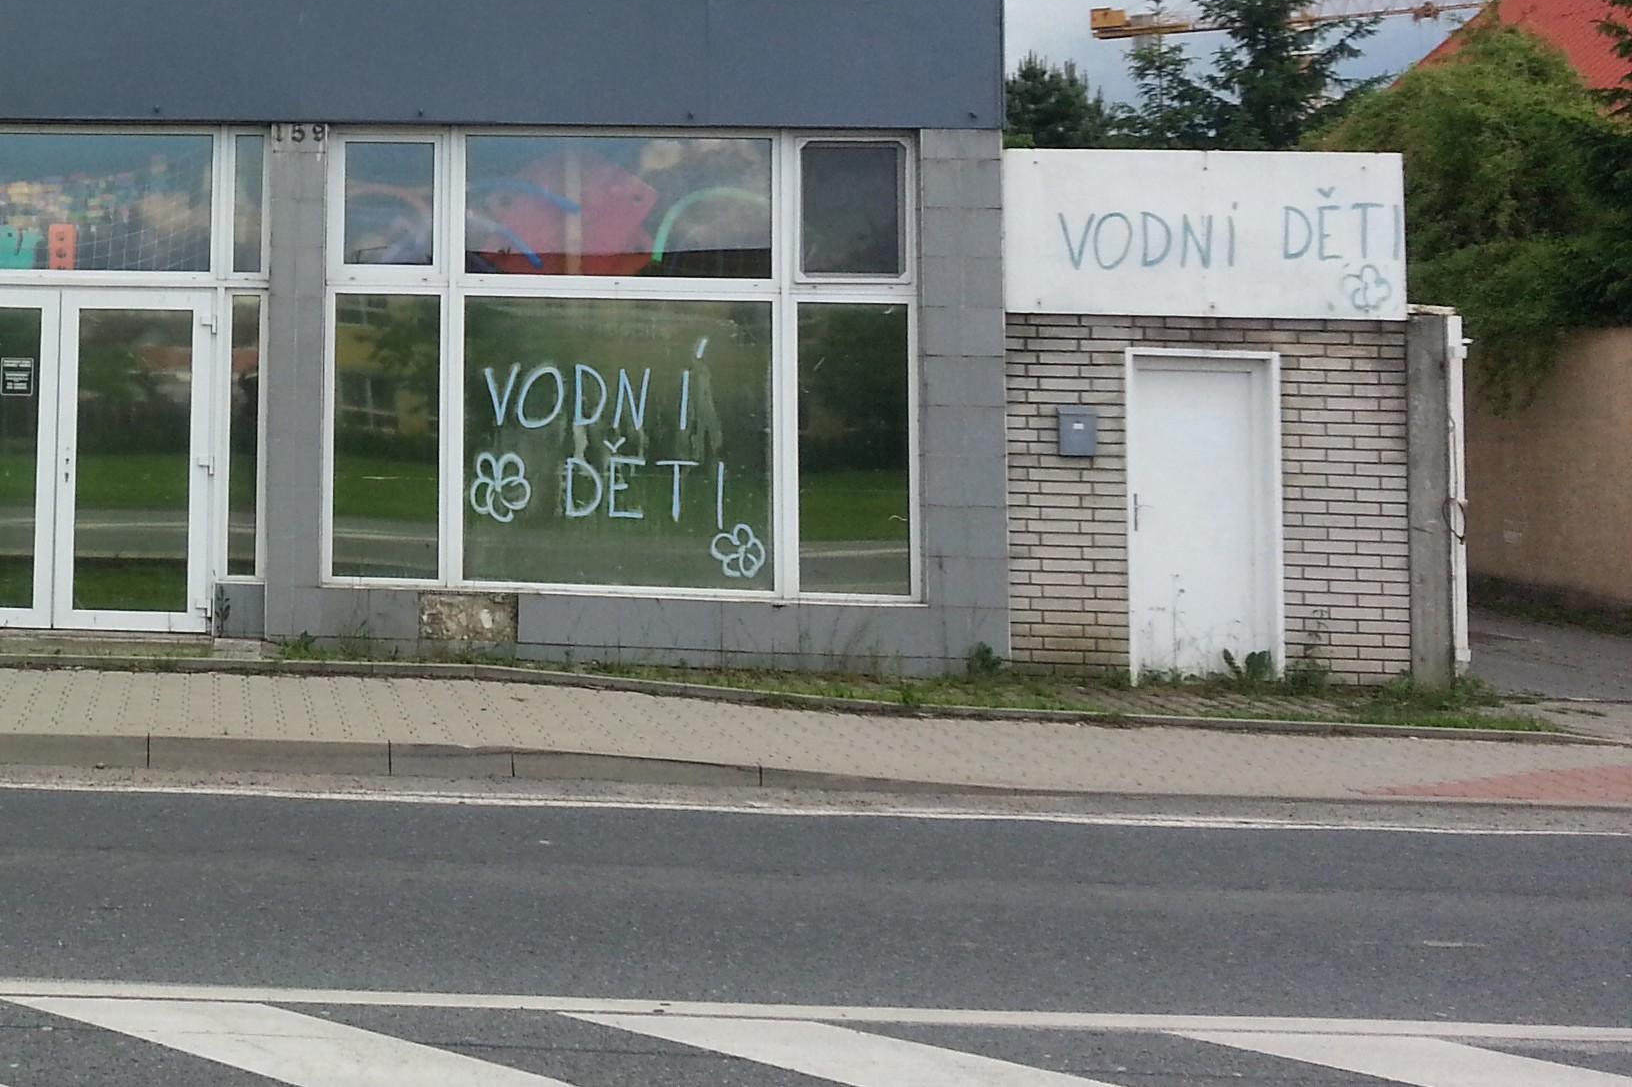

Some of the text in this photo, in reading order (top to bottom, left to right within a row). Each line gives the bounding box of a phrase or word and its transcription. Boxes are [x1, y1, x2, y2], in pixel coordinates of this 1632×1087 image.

[273, 123, 325, 143] 159
[1058, 186, 1402, 270] VODNÍ DĚTI
[484, 337, 708, 430] VODNÍ
[564, 436, 725, 530] DĚTI
